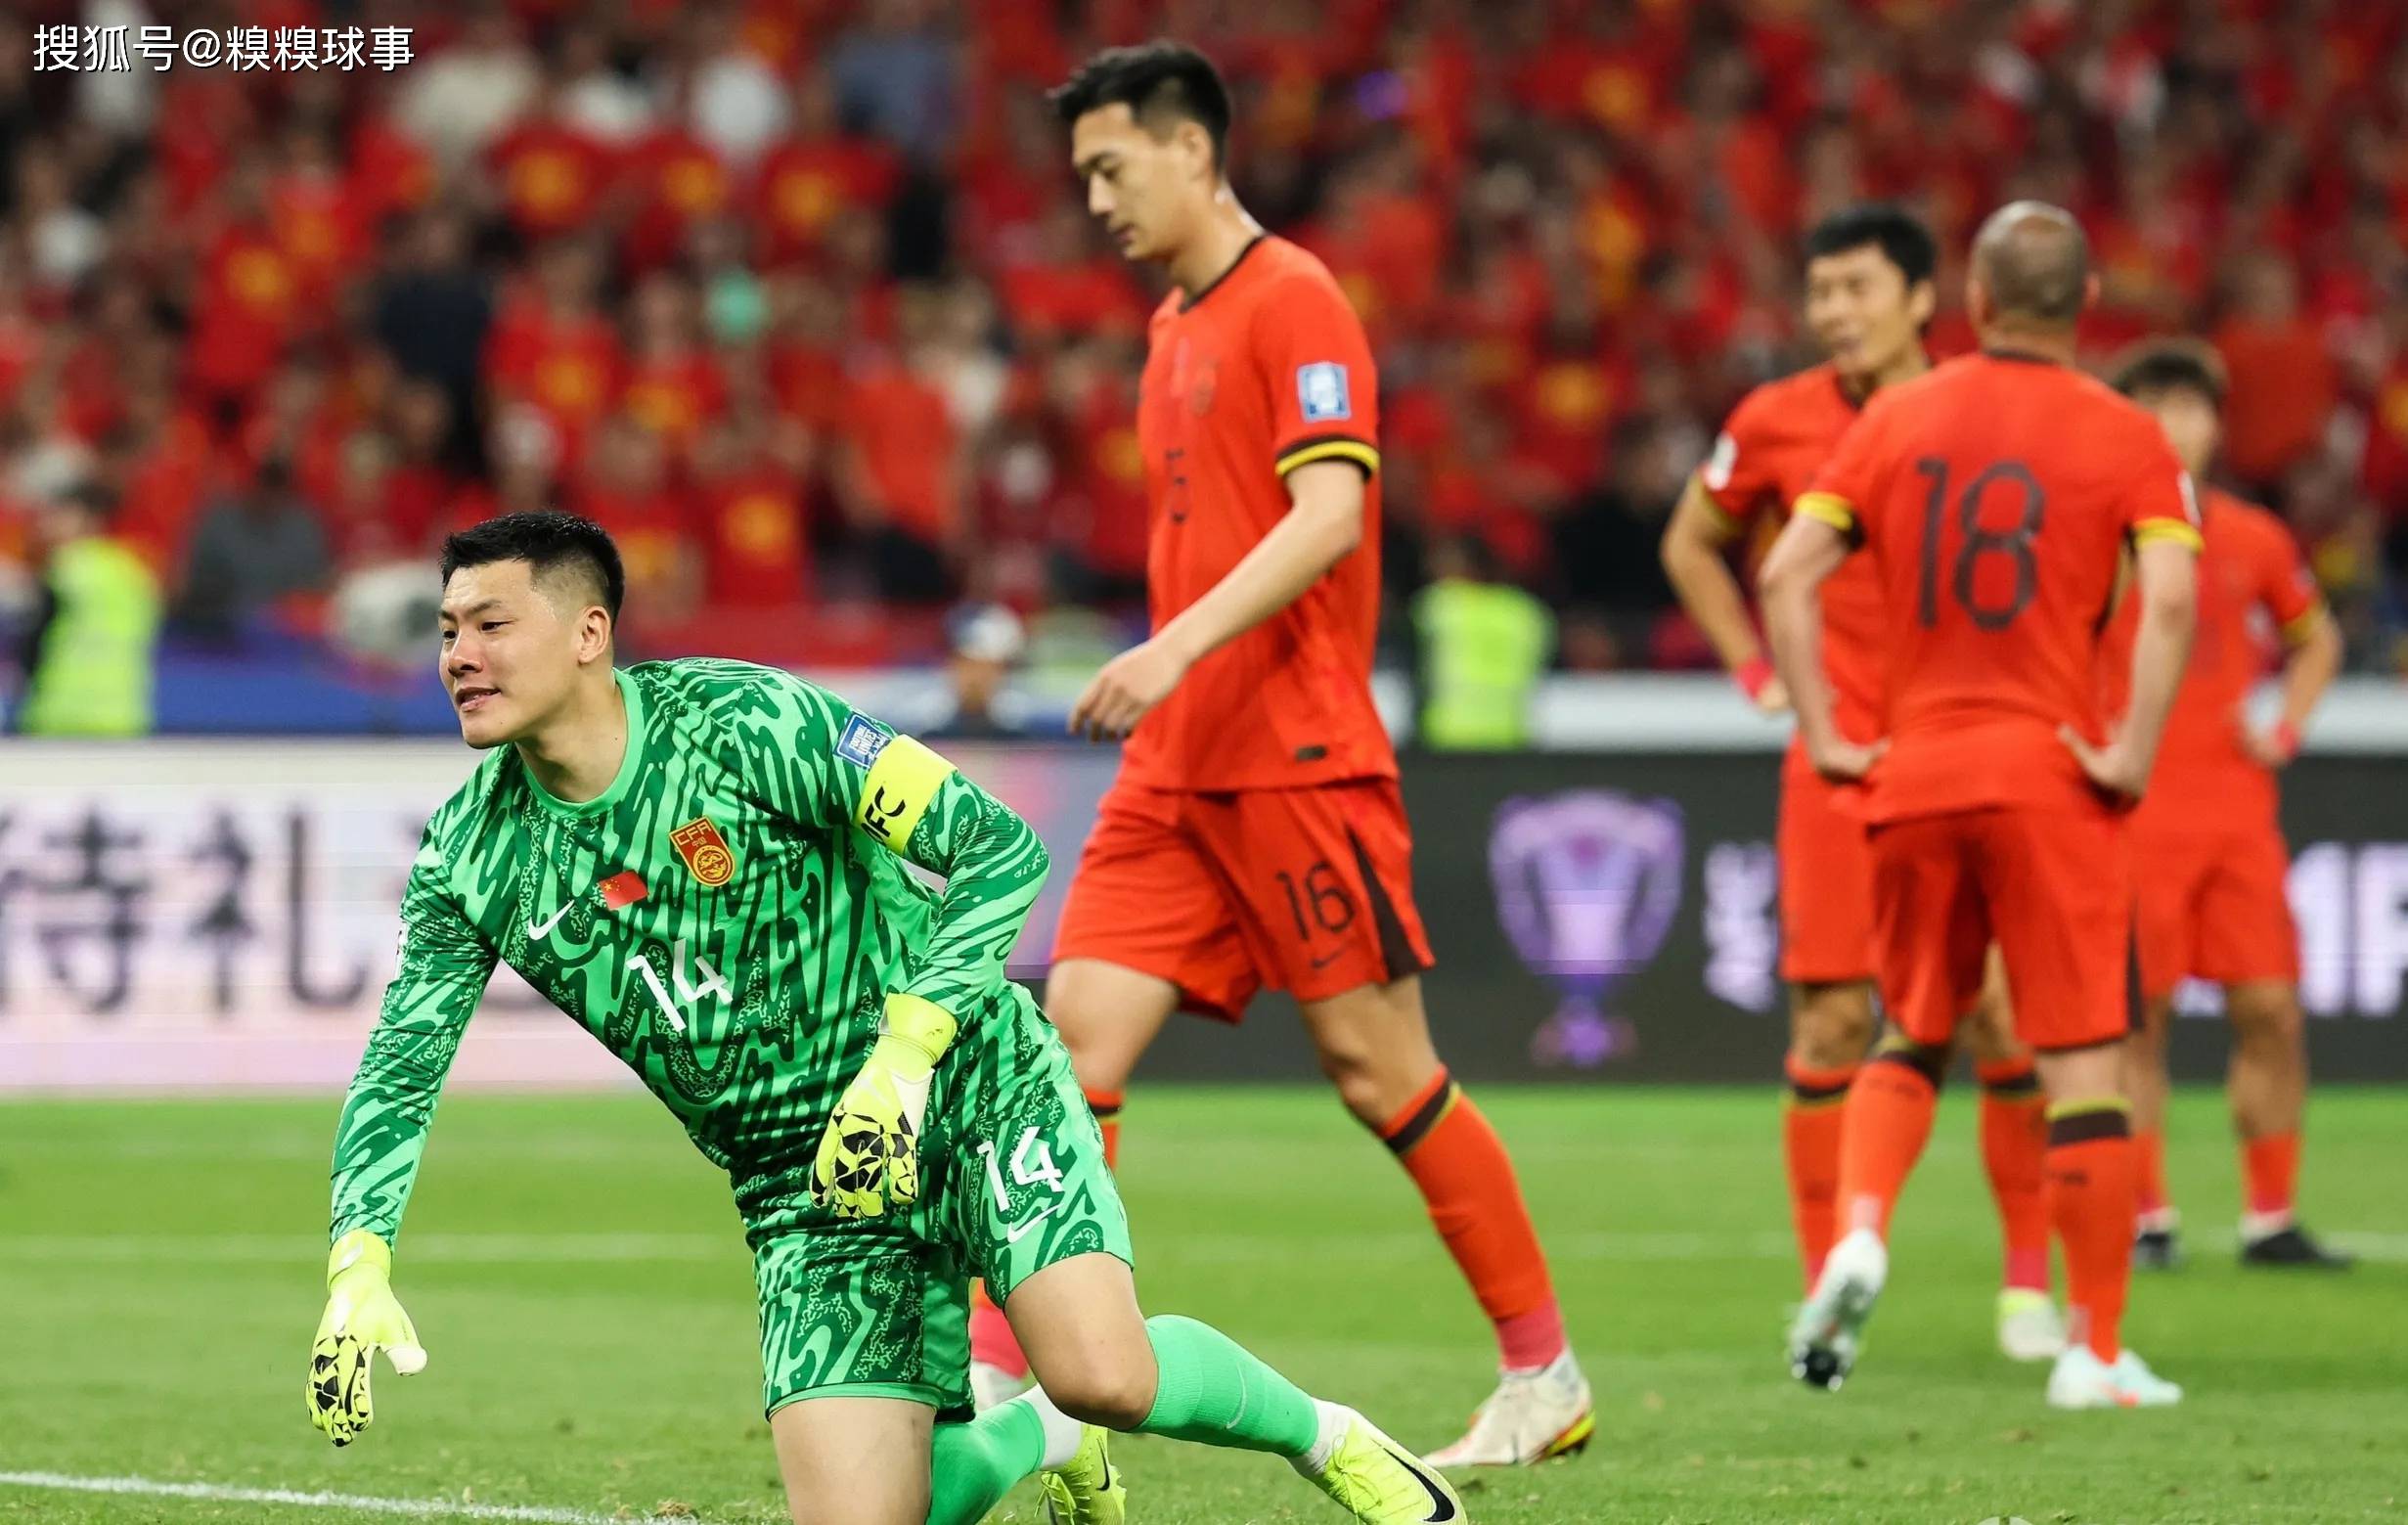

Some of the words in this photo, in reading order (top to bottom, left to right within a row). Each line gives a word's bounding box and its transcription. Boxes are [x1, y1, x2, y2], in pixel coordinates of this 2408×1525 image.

[1917, 456, 2046, 631] 18
[675, 821, 712, 846] CFA
[1276, 861, 1356, 941] 16
[625, 938, 734, 1032] 14
[977, 1126, 1065, 1212] 14
